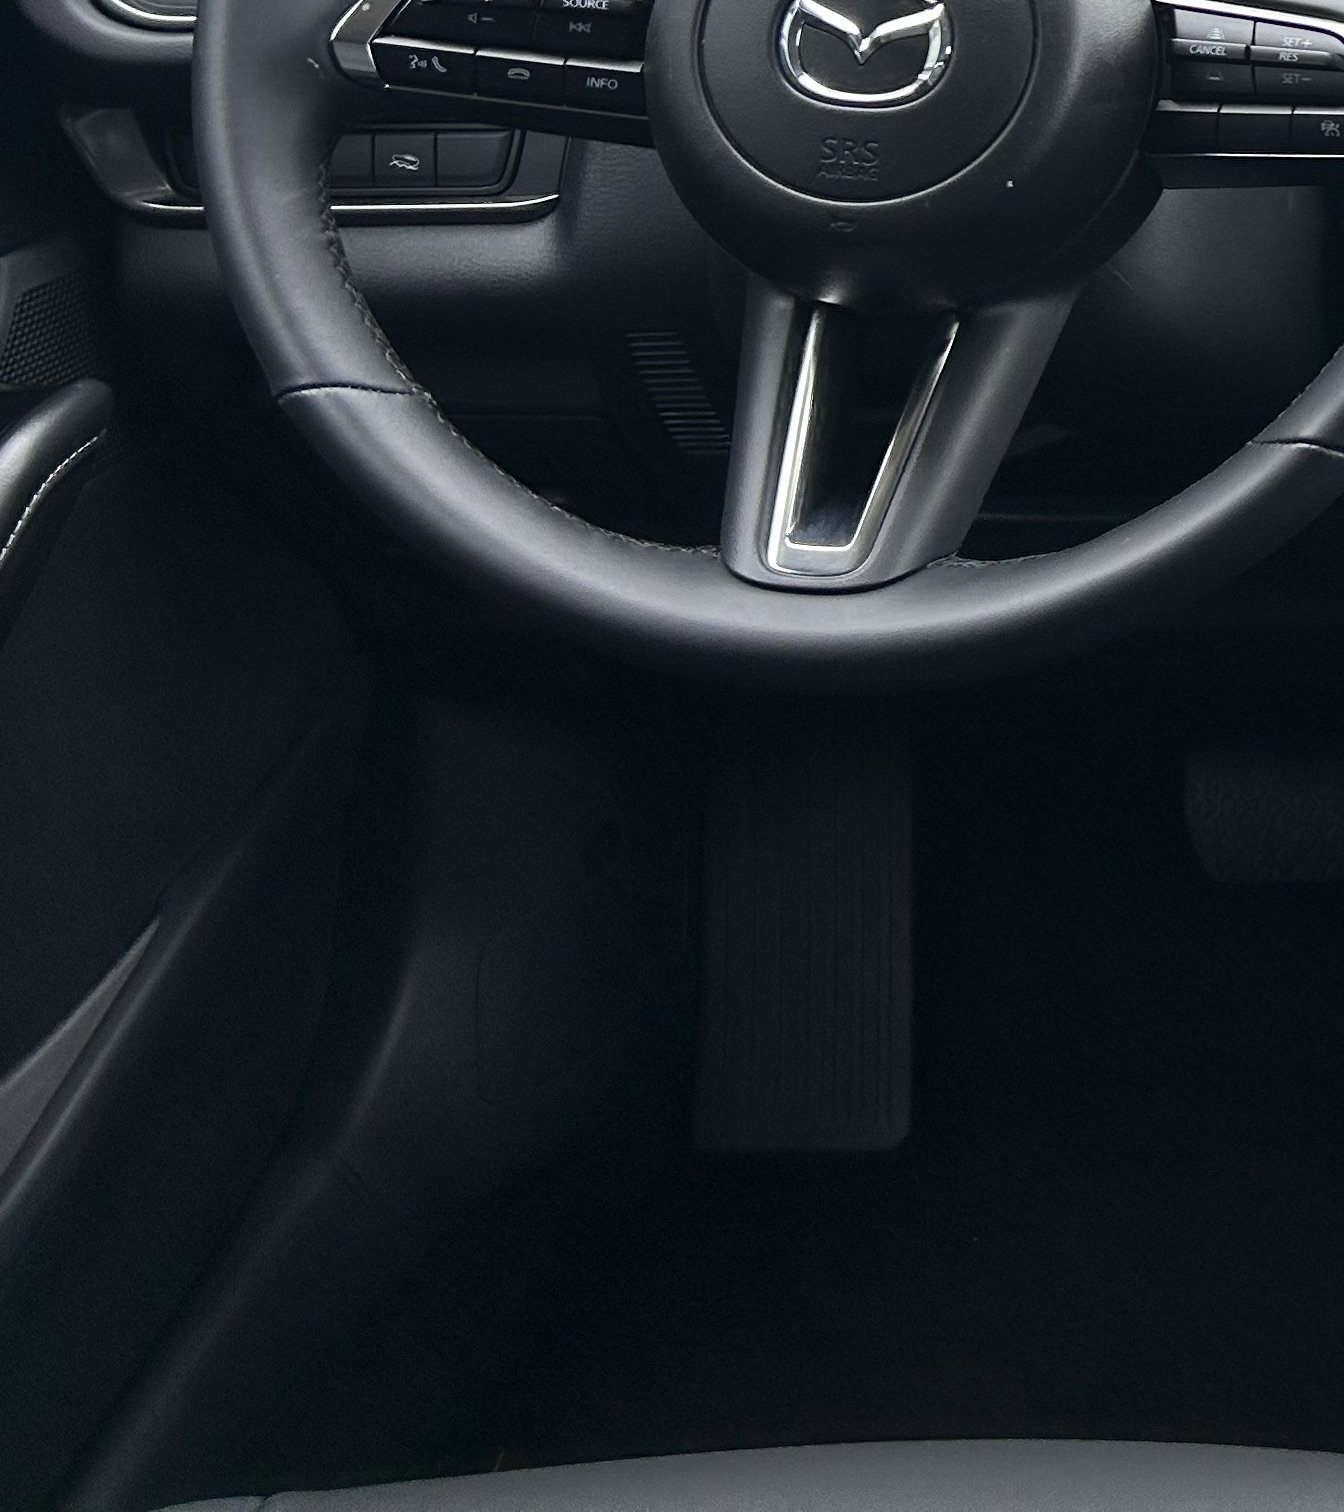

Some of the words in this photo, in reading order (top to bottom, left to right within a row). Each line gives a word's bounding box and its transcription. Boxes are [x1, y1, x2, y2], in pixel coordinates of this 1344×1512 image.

[1188, 45, 1227, 56] CANCEL
[1279, 51, 1299, 62] RES
[586, 76, 619, 90] INFO
[819, 138, 880, 167] SRS
